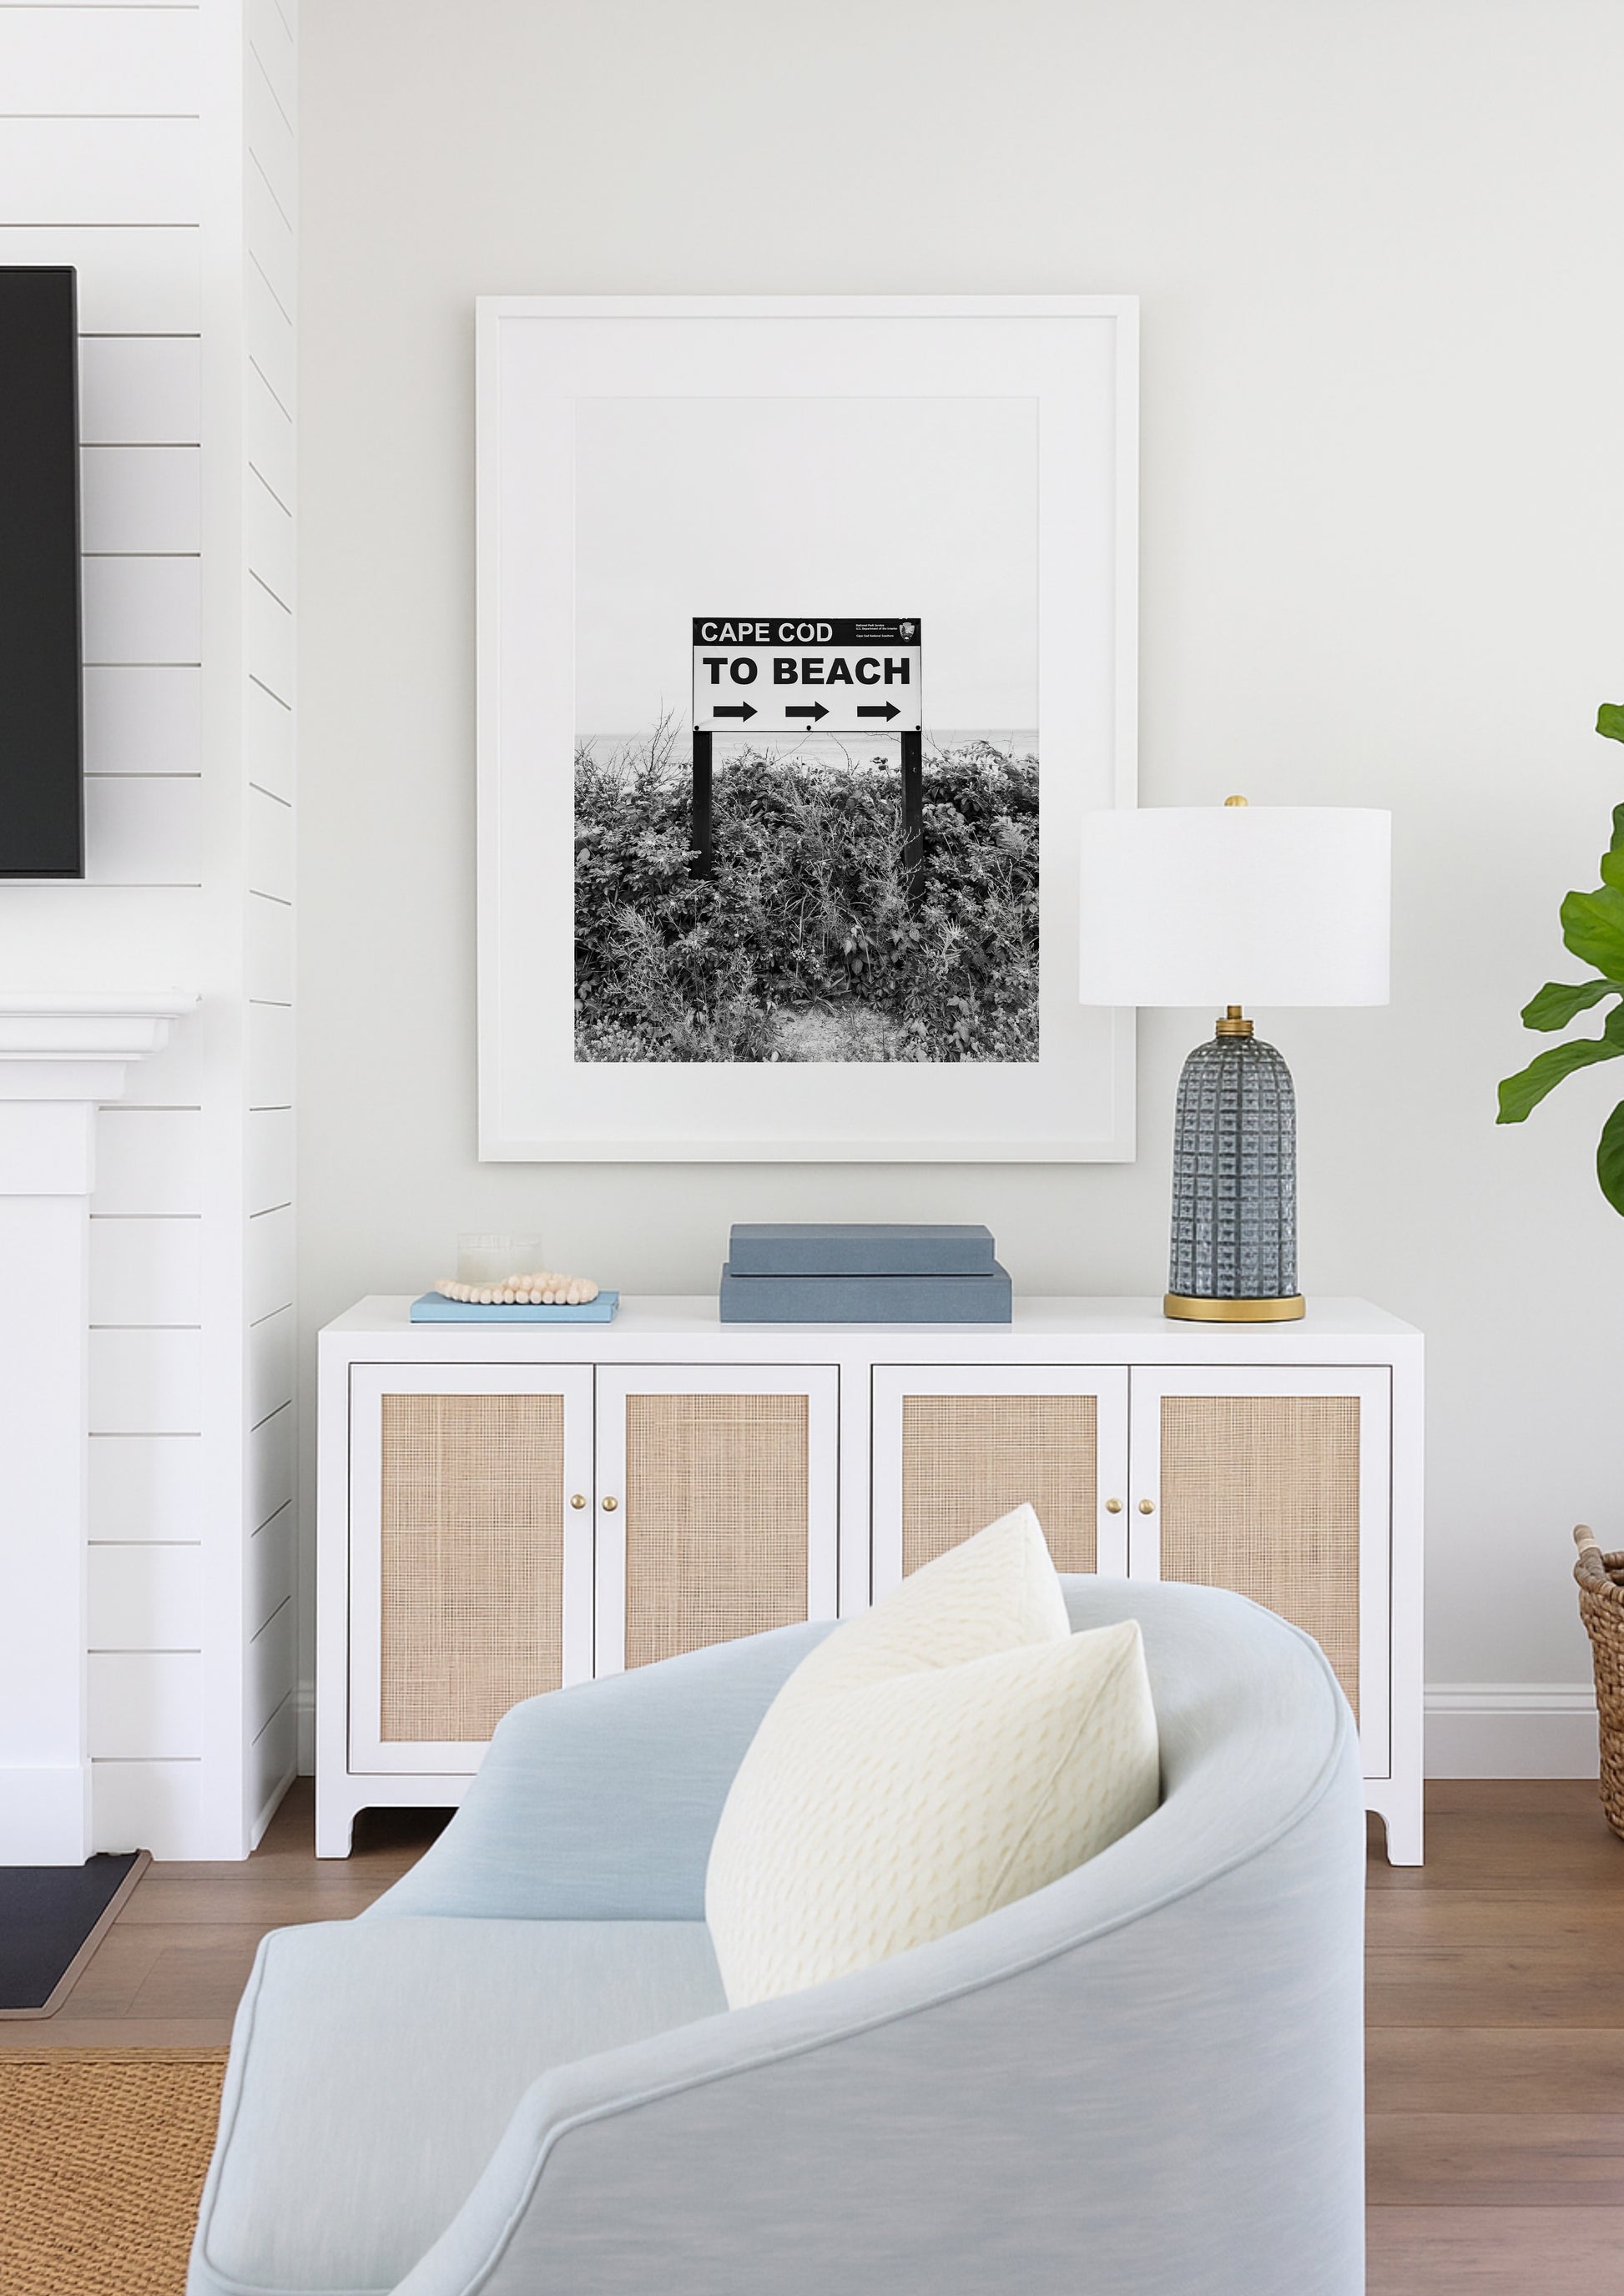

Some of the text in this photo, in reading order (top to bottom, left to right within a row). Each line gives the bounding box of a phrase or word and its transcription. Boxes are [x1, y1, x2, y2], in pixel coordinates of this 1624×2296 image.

[702, 622, 833, 642] CAPE COD
[703, 657, 910, 686] TO BEACH
